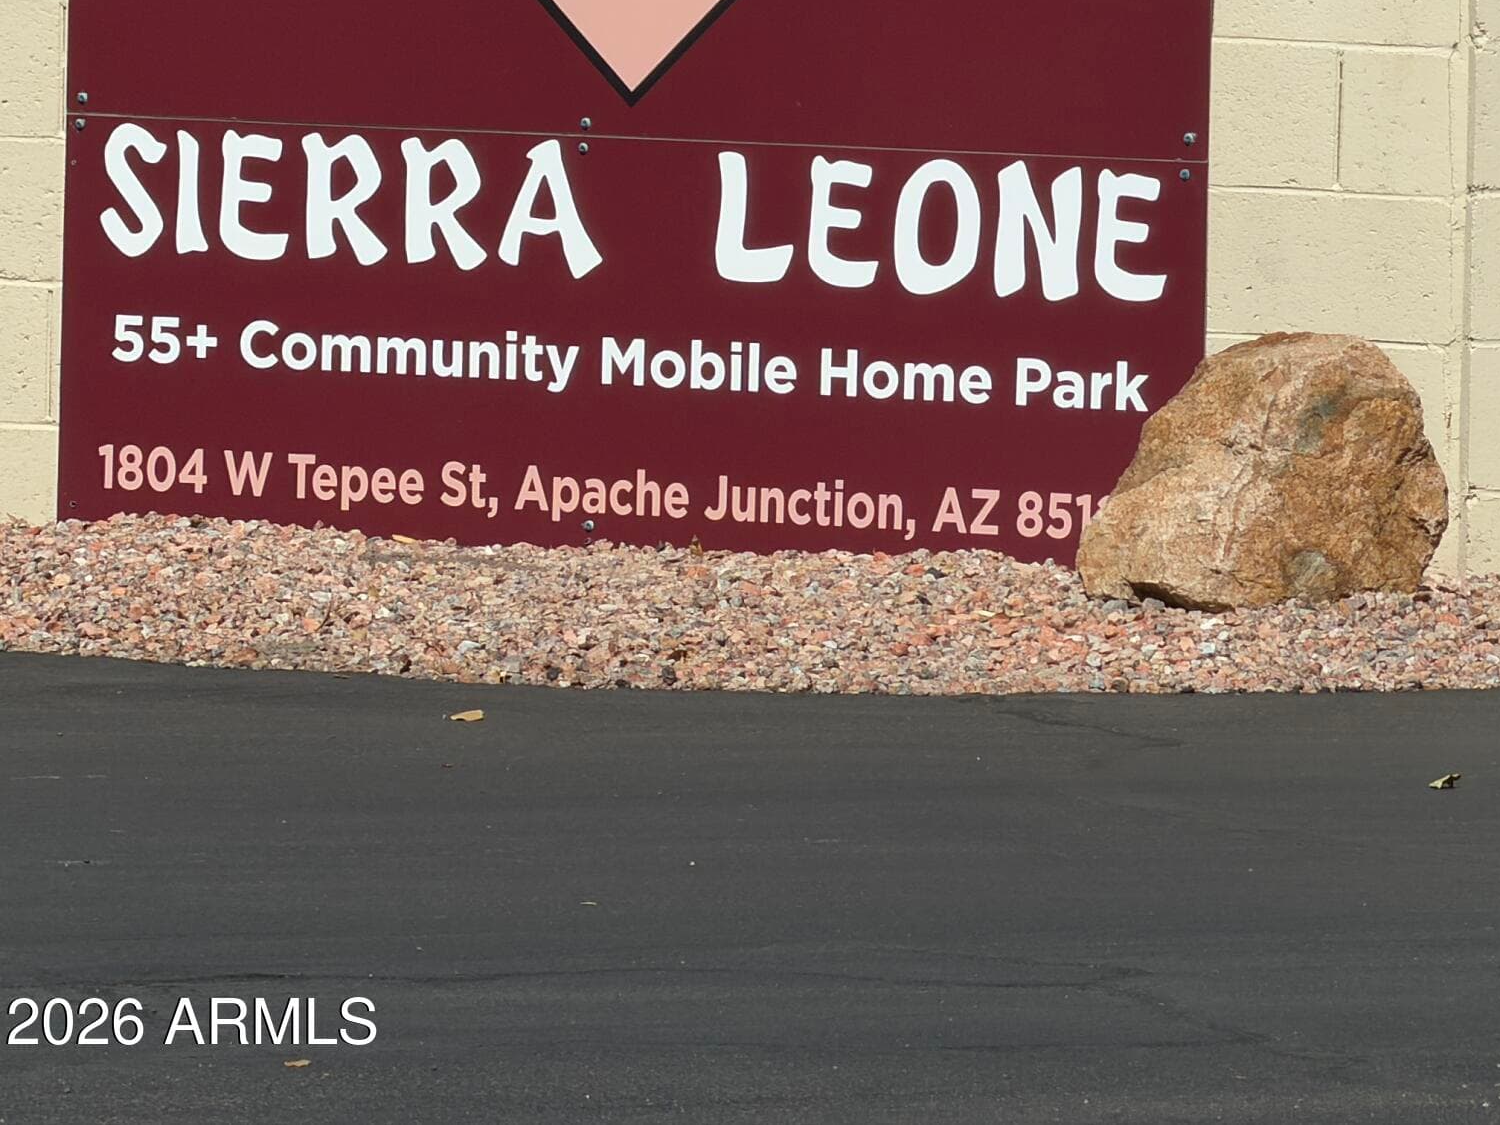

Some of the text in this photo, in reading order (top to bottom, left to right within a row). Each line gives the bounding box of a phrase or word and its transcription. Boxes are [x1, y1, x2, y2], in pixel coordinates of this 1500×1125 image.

[100, 123, 1168, 302] SIERRA LEONE
[111, 314, 1149, 412] 55+ Community Mobile Home Park
[99, 444, 1110, 540] 1804 W Tepee St, Apache Junction, AZ 851
